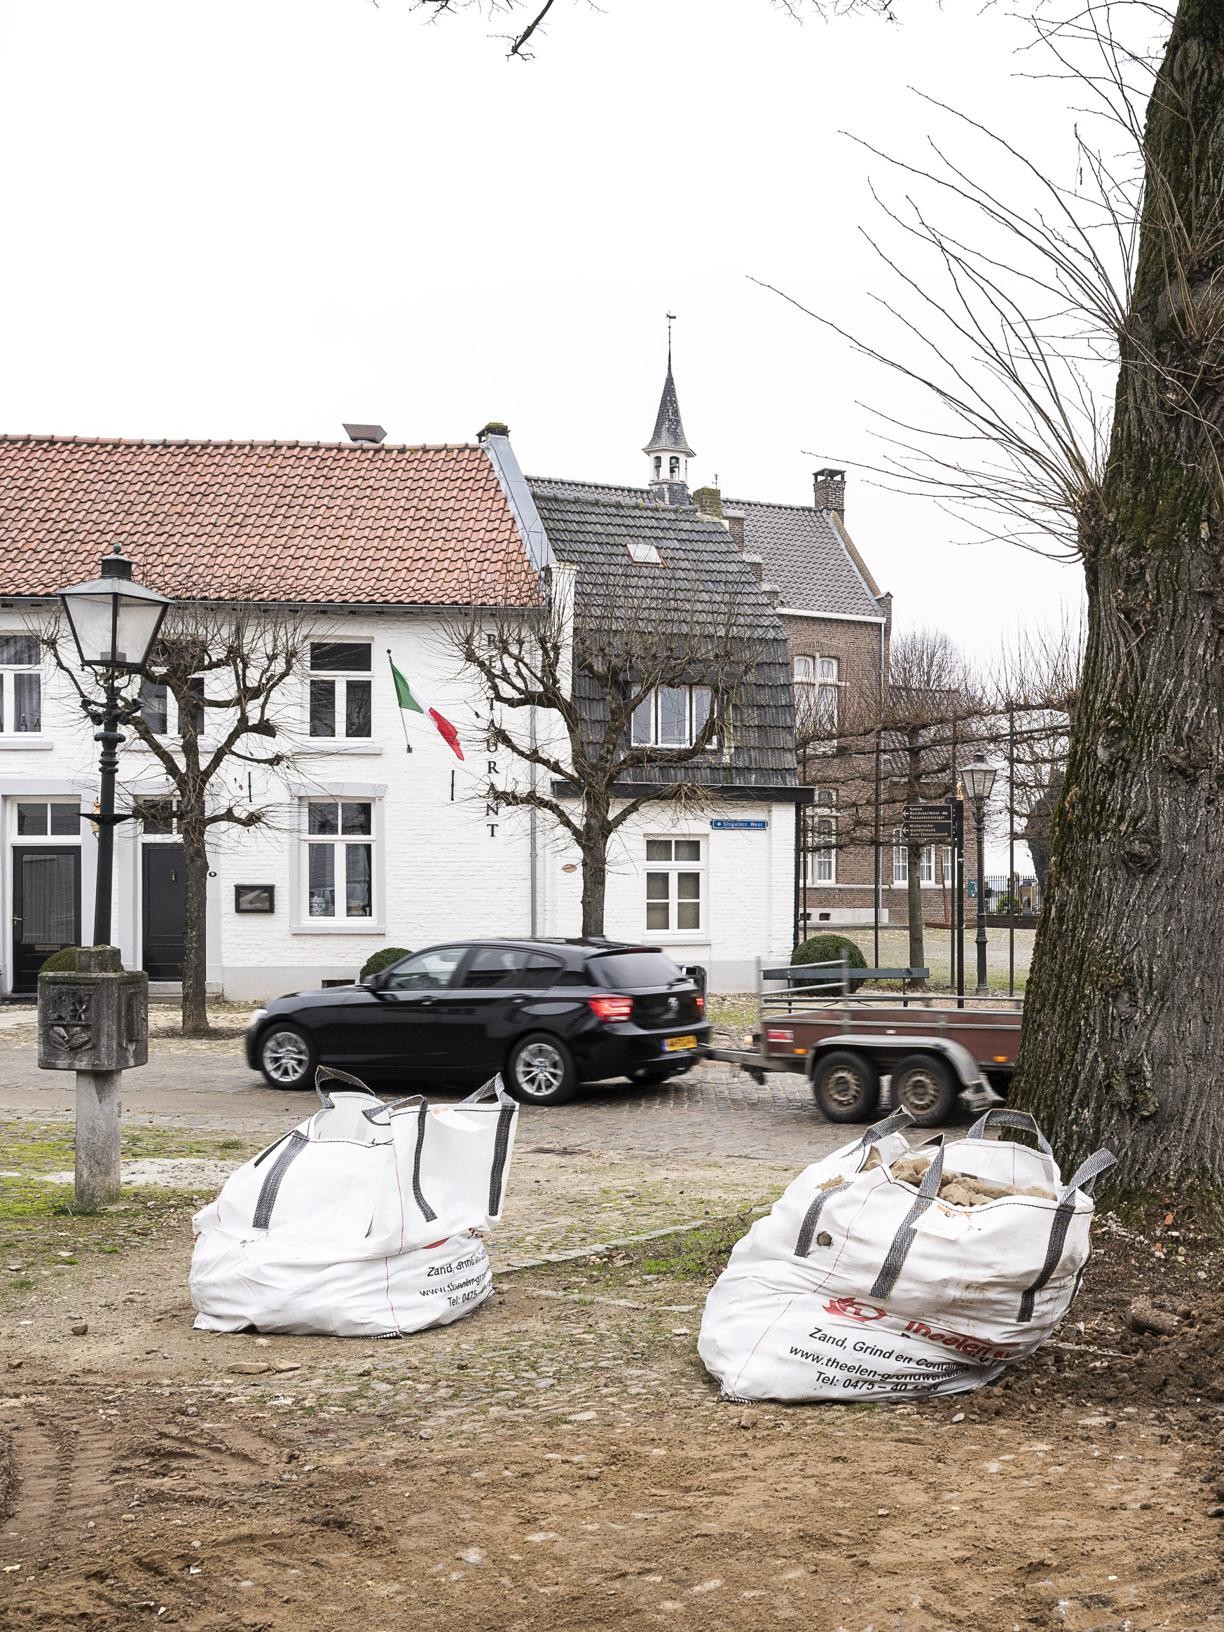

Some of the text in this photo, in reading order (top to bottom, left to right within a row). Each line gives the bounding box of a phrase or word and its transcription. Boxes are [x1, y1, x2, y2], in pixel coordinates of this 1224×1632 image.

[486, 633, 499, 838] RETAURANT
[447, 1296, 460, 1308] Tel:
[808, 1327, 848, 1351] Zand,
[852, 1341, 896, 1360] Grind
[895, 1353, 913, 1364] en
[815, 1370, 840, 1386] Tel:
[842, 1378, 875, 1391] 0475
